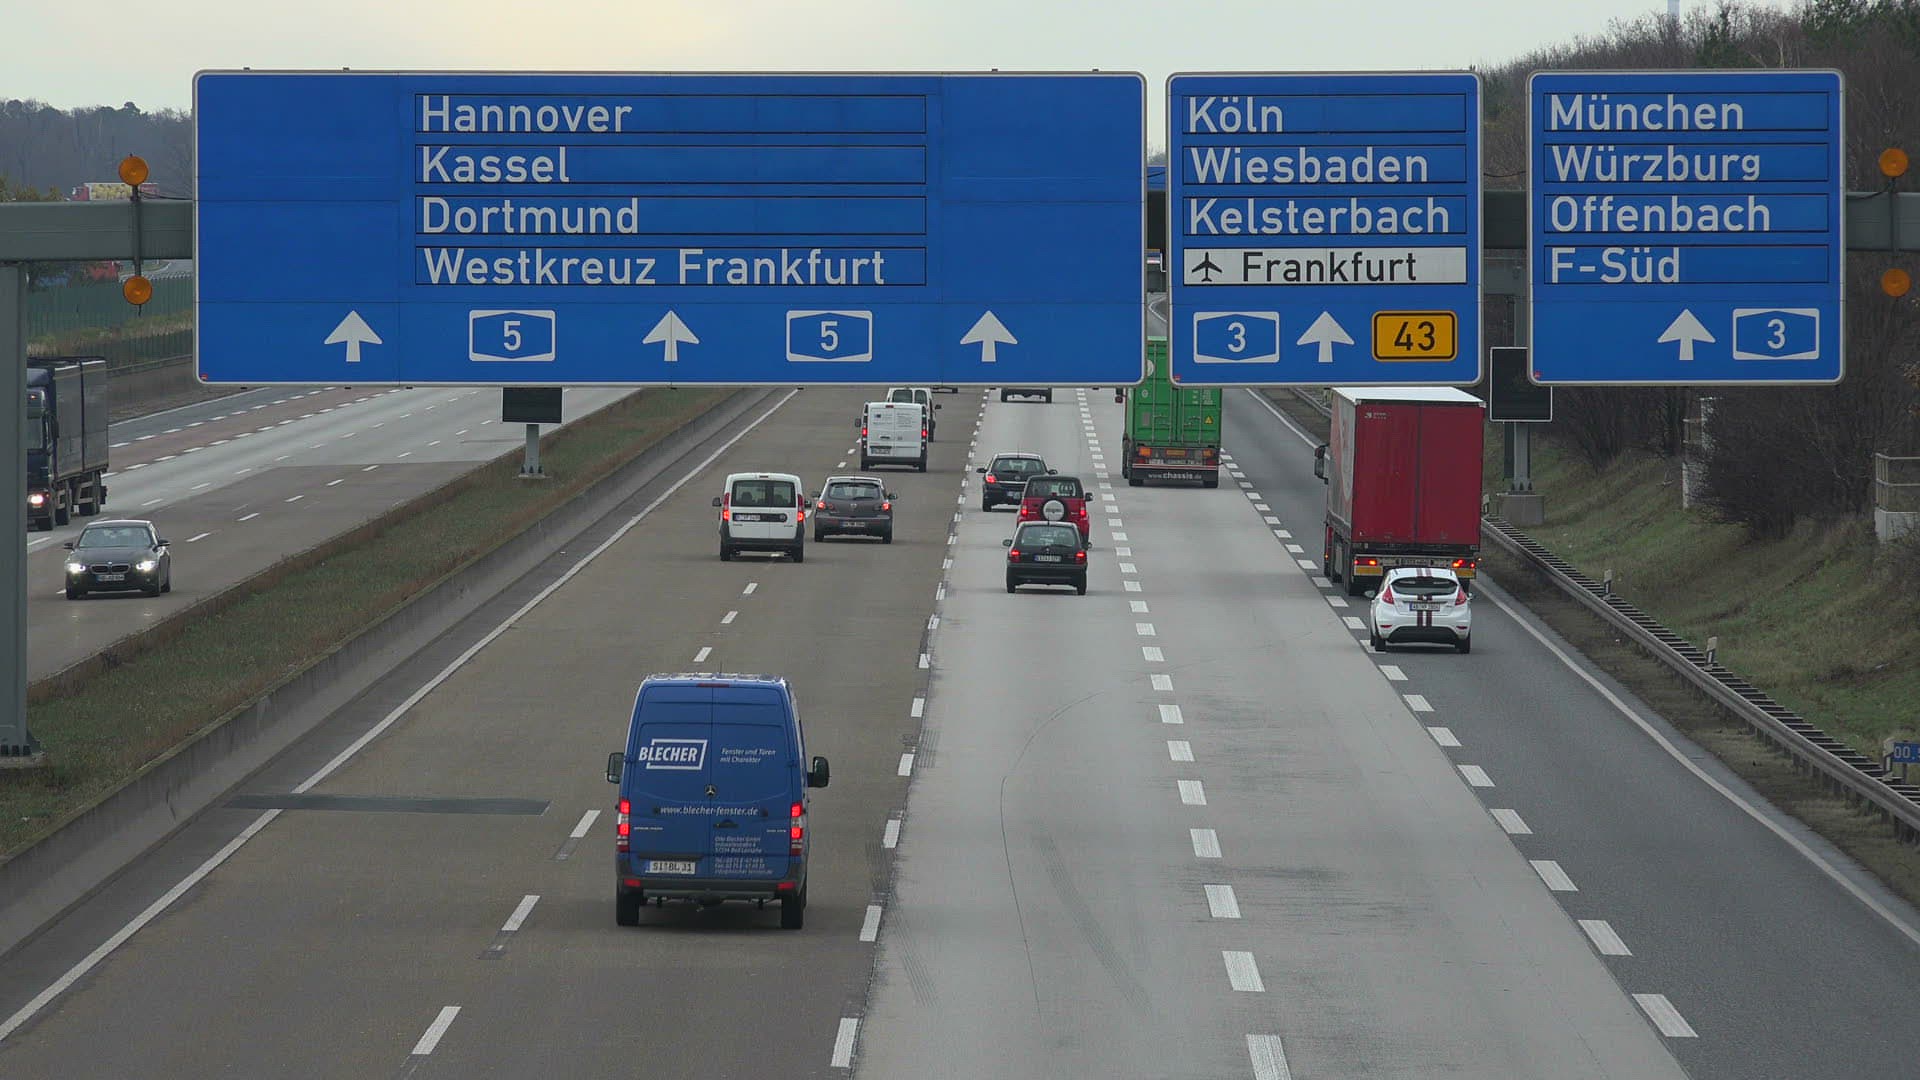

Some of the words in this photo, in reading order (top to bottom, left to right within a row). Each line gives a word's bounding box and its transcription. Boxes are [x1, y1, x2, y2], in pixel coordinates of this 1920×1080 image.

[422, 95, 632, 133] Hannover
[1189, 96, 1284, 133] Köln
[1550, 93, 1744, 131] München
[422, 146, 570, 183] Kassel
[1190, 146, 1428, 183] Wiesbaden
[1551, 144, 1761, 182] Würzburg
[422, 196, 639, 233] Dortmund
[1190, 197, 1449, 234] Kelsterbach
[1550, 195, 1770, 232] Offenbach
[424, 247, 656, 285] Westkreuz
[679, 248, 885, 285] Frankfurt
[1243, 251, 1417, 282] Frankfurt
[1550, 247, 1680, 284] F-Süd
[502, 320, 521, 351] 5
[820, 320, 839, 352] 5
[1227, 321, 1246, 353] 3
[1394, 321, 1436, 351] 43
[1766, 318, 1786, 349] 3
[639, 746, 697, 762] BLECHER
[1894, 746, 1920, 760] 00.
[660, 806, 759, 816] www.blecher-fenster.de
